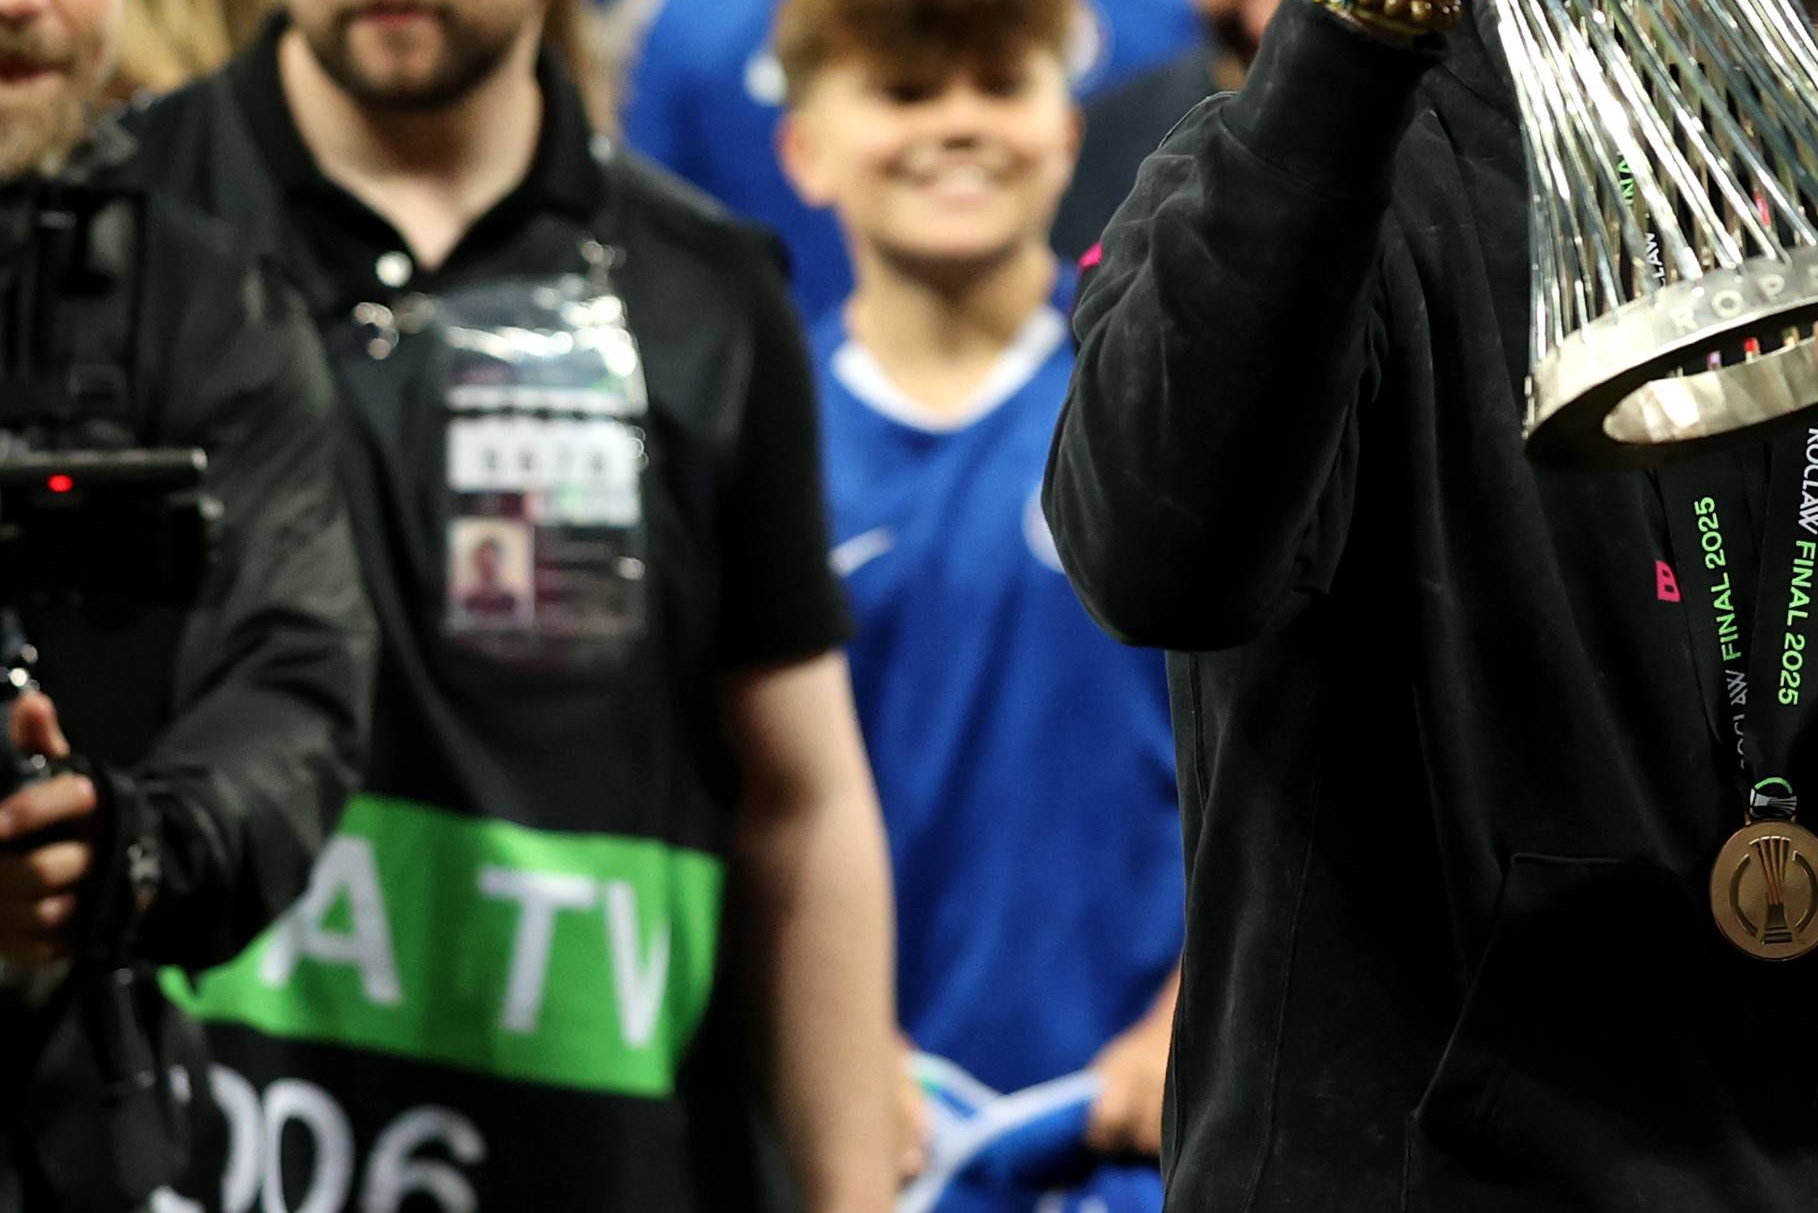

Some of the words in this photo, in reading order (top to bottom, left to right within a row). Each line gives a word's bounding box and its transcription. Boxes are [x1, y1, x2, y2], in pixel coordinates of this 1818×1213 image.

[1694, 497, 1726, 569] 2025
[1711, 572, 1742, 661] FINAL
[1787, 540, 1817, 626] FINAL
[1778, 632, 1806, 705] 2025
[256, 832, 402, 1006] A
[477, 862, 674, 1050] TV
